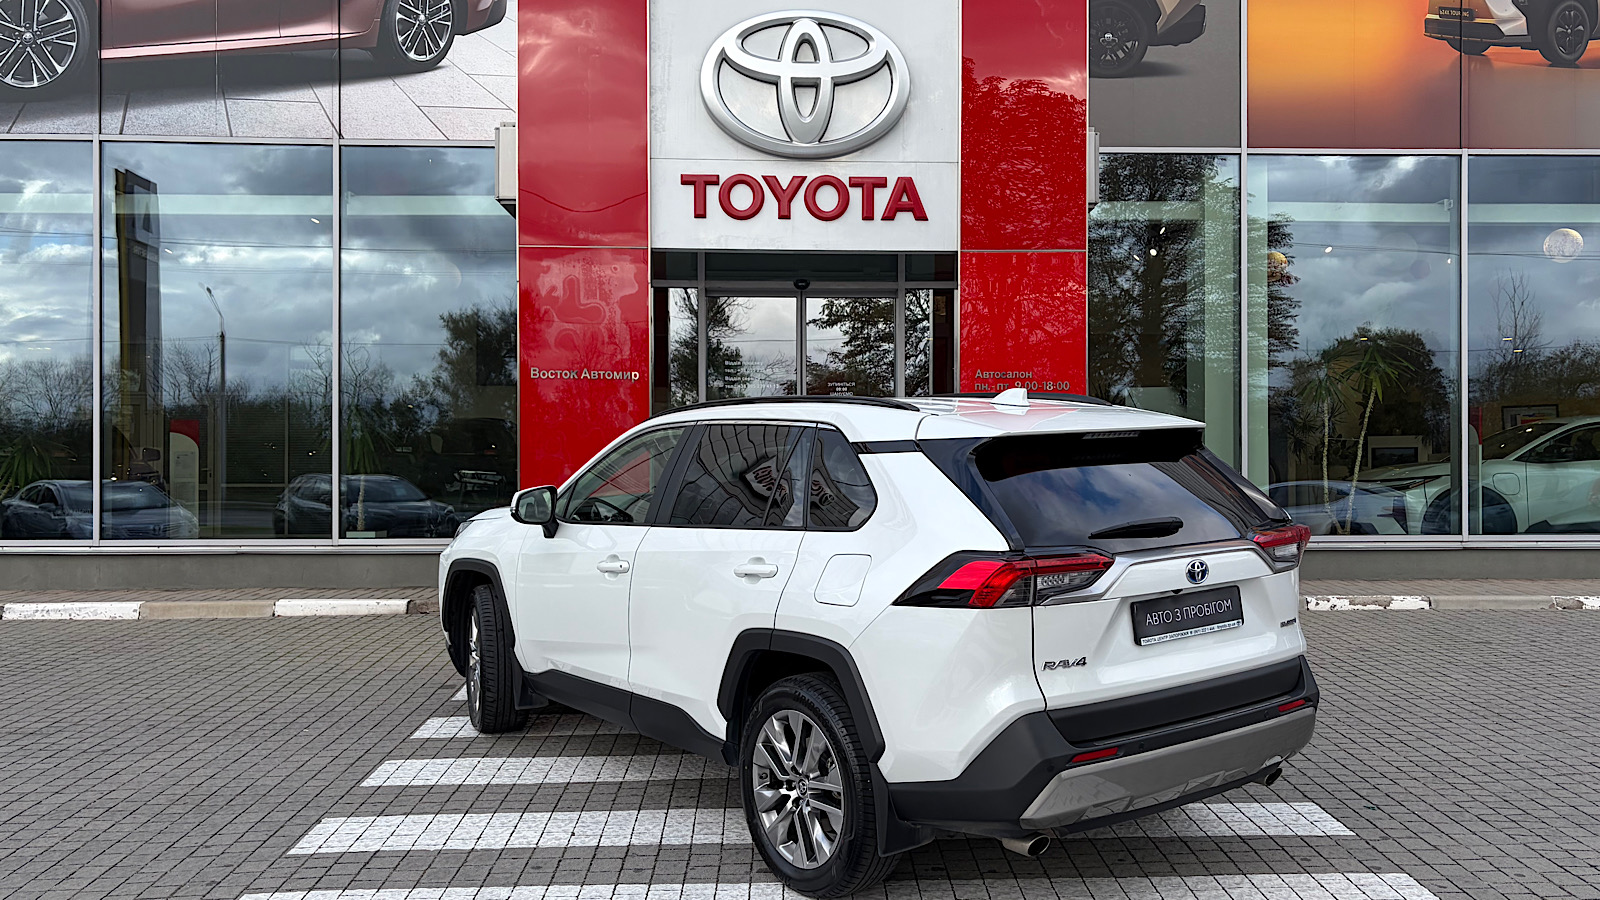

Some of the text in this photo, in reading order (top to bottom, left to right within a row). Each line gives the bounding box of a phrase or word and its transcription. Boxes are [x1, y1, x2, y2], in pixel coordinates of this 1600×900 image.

[1450, 9, 1469, 17] TOURNG
[680, 173, 929, 222] TOYOTA
[530, 367, 640, 383] Восток Автомир
[975, 369, 1033, 379] Автосалон
[1146, 610, 1172, 626] АВТО
[1183, 599, 1233, 619] ПРОБІГОМ
[1041, 656, 1087, 671] RAV4
